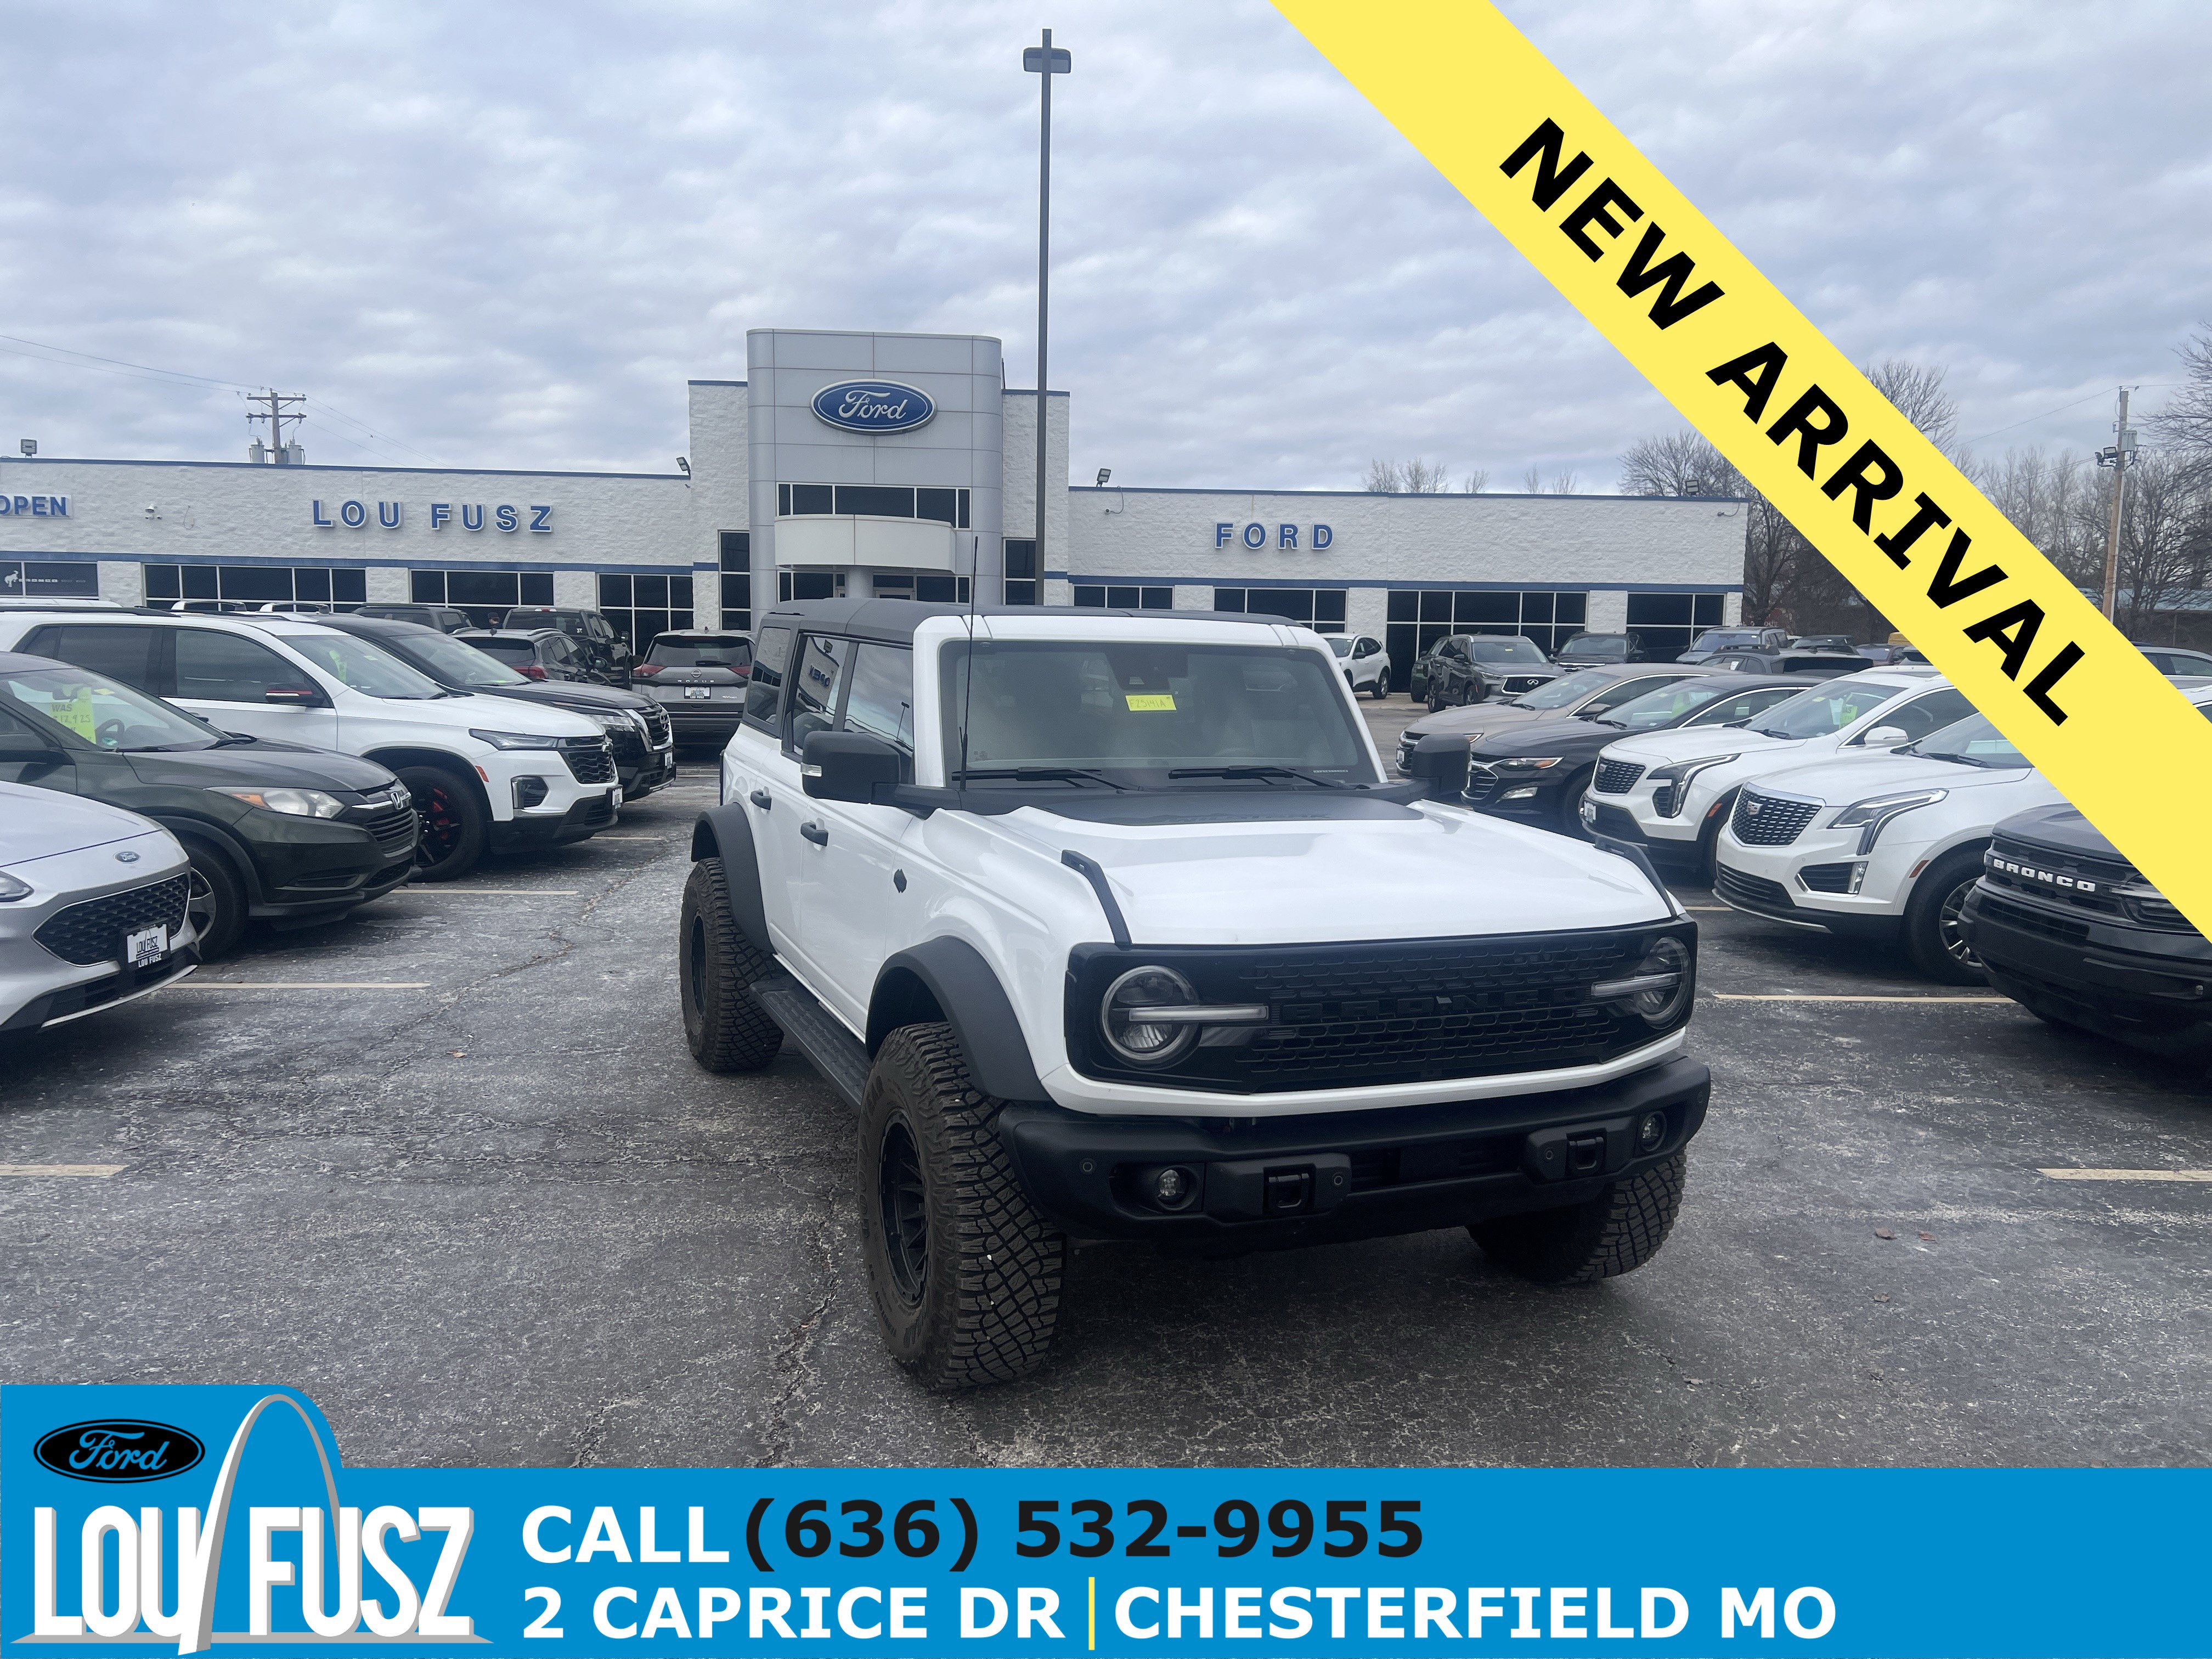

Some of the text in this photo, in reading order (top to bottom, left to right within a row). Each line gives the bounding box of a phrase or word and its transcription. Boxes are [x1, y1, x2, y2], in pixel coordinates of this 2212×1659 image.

[838, 390, 908, 420] Ford
[0, 495, 66, 516] OPEN
[313, 500, 552, 532] LOU FUSZ
[1215, 522, 1333, 550] FORD
[52, 703, 72, 712] WAS
[1993, 858, 2096, 893] BRONCO
[138, 957, 148, 968] LOU
[149, 953, 162, 964] FUSZ
[1282, 986, 1585, 1022] BRONCO
